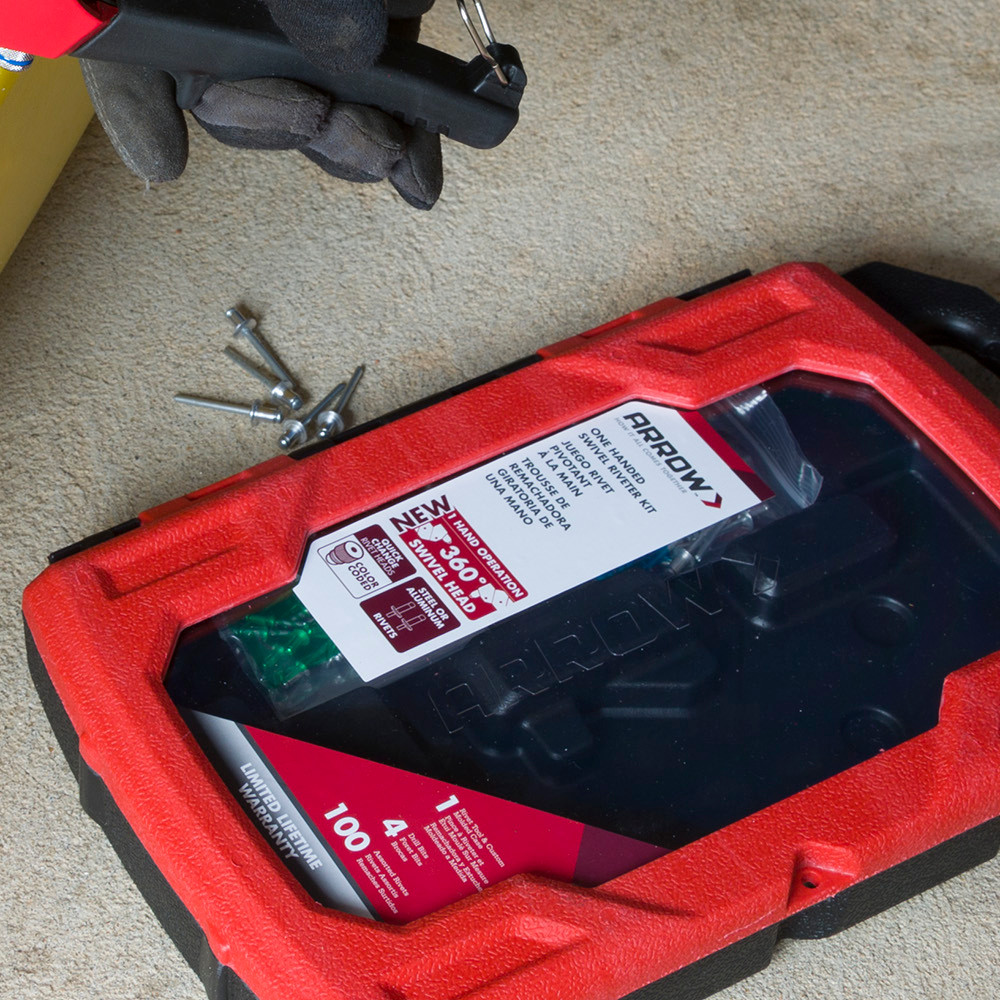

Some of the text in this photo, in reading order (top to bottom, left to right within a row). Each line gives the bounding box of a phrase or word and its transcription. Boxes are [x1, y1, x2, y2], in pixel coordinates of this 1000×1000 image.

[537, 450, 584, 498] À LA MAIN
[550, 445, 593, 488] PIVOTANT
[561, 440, 616, 495] JUEGO RIVET
[578, 432, 658, 515] SWIVEL RIVETER KIT
[590, 427, 646, 485] ONE HANDED
[614, 417, 629, 431] HOW
[633, 437, 643, 448] ALL
[642, 447, 661, 467] COMES
[660, 466, 688, 494] TOGETHER
[622, 411, 714, 491] ARROW
[485, 473, 534, 526] UNA MANO
[497, 468, 554, 530] GIRATORIA DE
[508, 462, 572, 532] REMACHADORA
[521, 457, 571, 510] TROUSSE DE
[389, 494, 451, 533] NEW
[360, 536, 396, 577] RIVET HEADS
[370, 538, 400, 569] CHANGE
[380, 538, 404, 562] QUICK
[447, 512, 525, 598] 1 HAND OPERATION
[347, 565, 372, 591] CODED
[355, 561, 380, 588] COLOR
[408, 538, 476, 613] SWIVEL HEAD
[372, 612, 399, 639] RIVETS
[405, 587, 446, 630] ALUMINUM
[418, 587, 450, 621] STEEL OR
[238, 782, 300, 860] WARRANTY
[240, 762, 323, 871] LIMITED LIFETIME
[324, 801, 371, 852] 100
[435, 794, 460, 813] 1
[382, 819, 409, 838] 4
[390, 840, 409, 863] Brocas
[399, 836, 424, 867] Foret Bits
[407, 832, 430, 860] Drill Bits
[429, 821, 461, 863] Remachadora
[444, 814, 459, 833] Pince
[460, 836, 479, 859] Riveter
[476, 858, 485, 867] et
[452, 810, 484, 850] Molded Case
[459, 807, 474, 825] Rivet
[471, 823, 485, 838] Tool
[485, 843, 505, 868] Custom
[364, 853, 400, 899] Rivets Assortis
[372, 850, 410, 897] Assorted Rivets
[423, 824, 448, 855] Moldeado
[448, 858, 468, 884] Medida
[461, 849, 473, 862] Sur
[469, 860, 489, 885] Mesure
[356, 857, 399, 914] Remaches Surtidos
